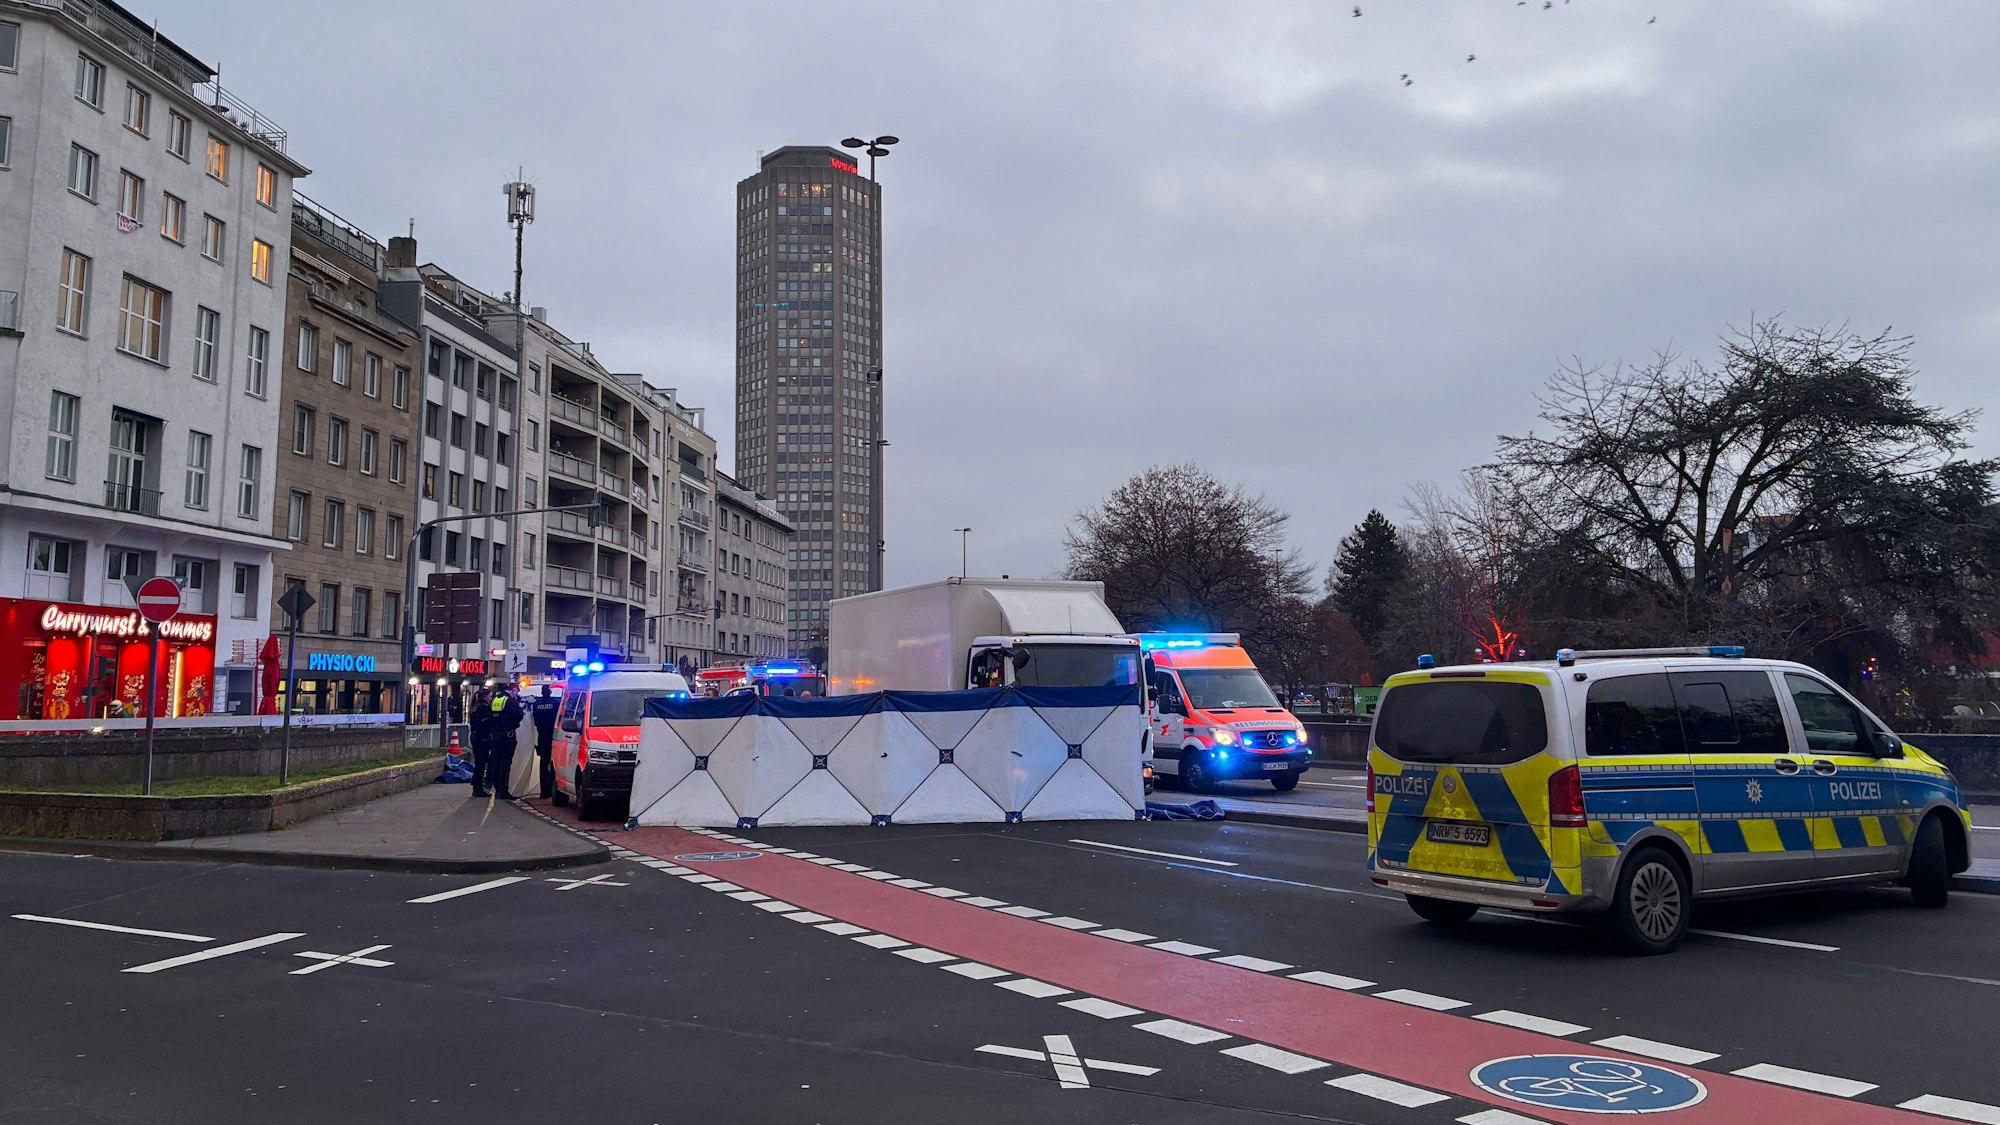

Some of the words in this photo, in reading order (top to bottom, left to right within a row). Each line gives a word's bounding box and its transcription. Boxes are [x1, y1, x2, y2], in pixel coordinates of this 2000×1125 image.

[42, 605, 136, 637] Currywurst
[137, 616, 150, 637] &
[158, 620, 212, 641] ommes
[309, 653, 353, 671] PHYSIO
[355, 655, 375, 672] CKI
[460, 660, 485, 674] KIOSK
[1375, 776, 1429, 796] POLIZEI
[1829, 782, 1881, 800] POLIZEI
